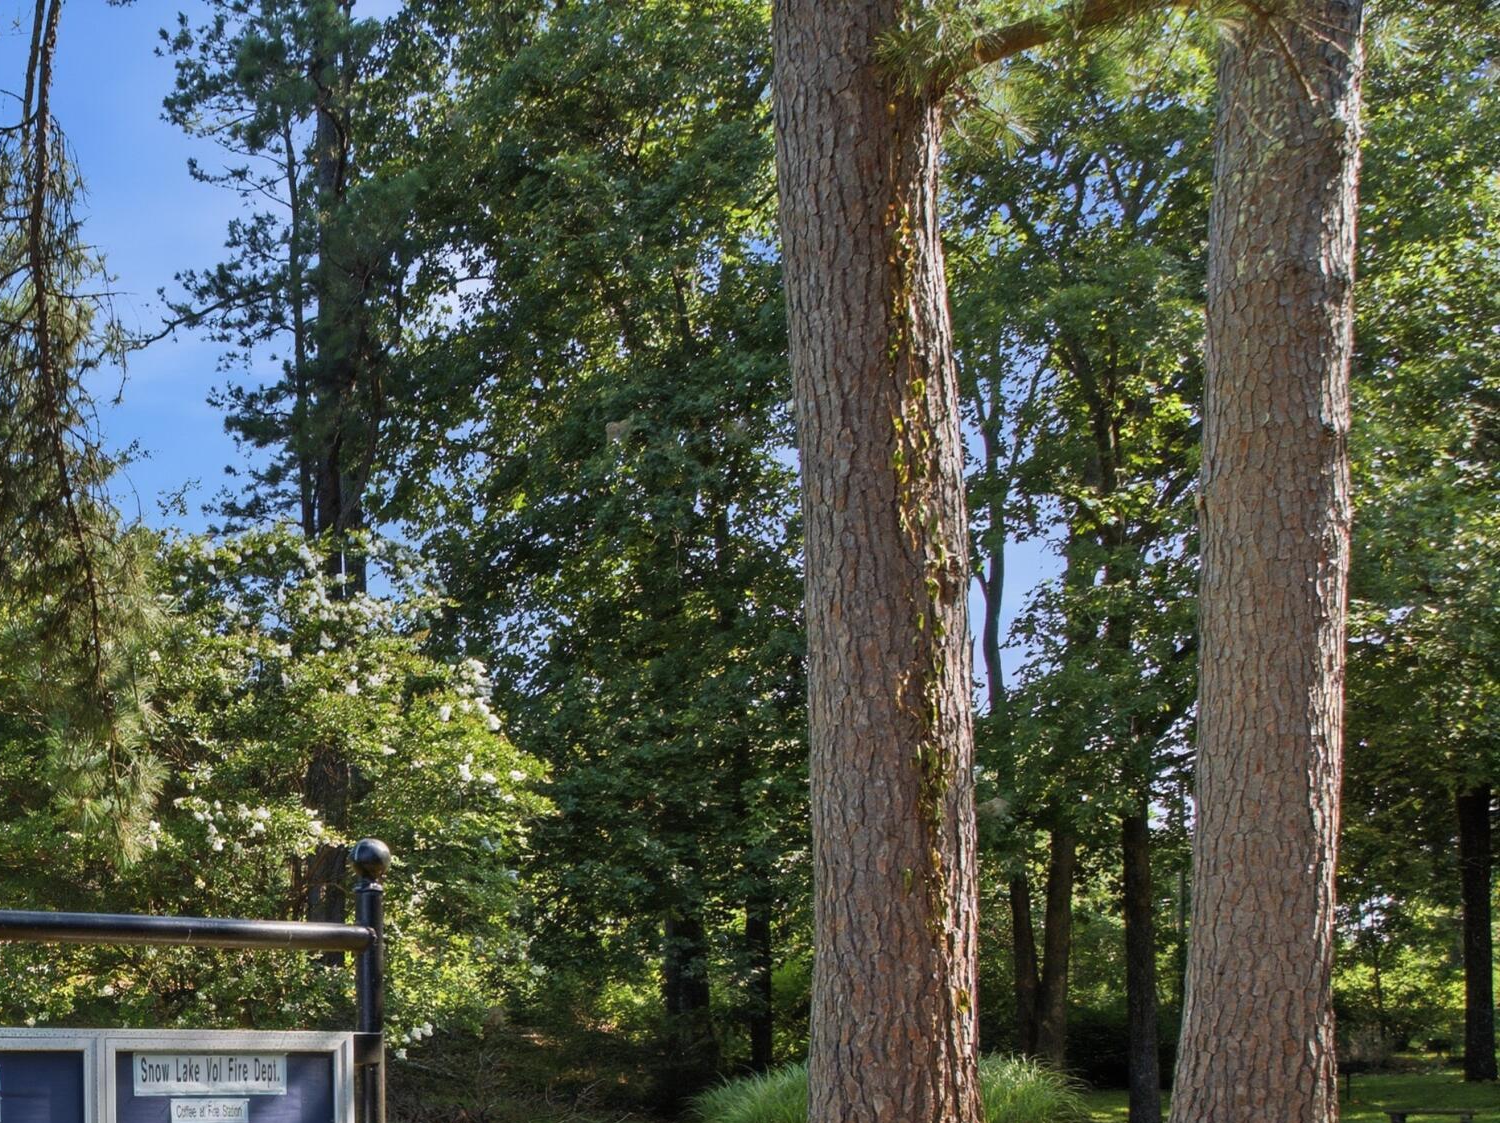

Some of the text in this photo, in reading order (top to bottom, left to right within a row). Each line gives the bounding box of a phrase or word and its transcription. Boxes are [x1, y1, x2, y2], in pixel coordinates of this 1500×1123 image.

[140, 1056, 281, 1088] Snow Lake Vol Fire Dept.
